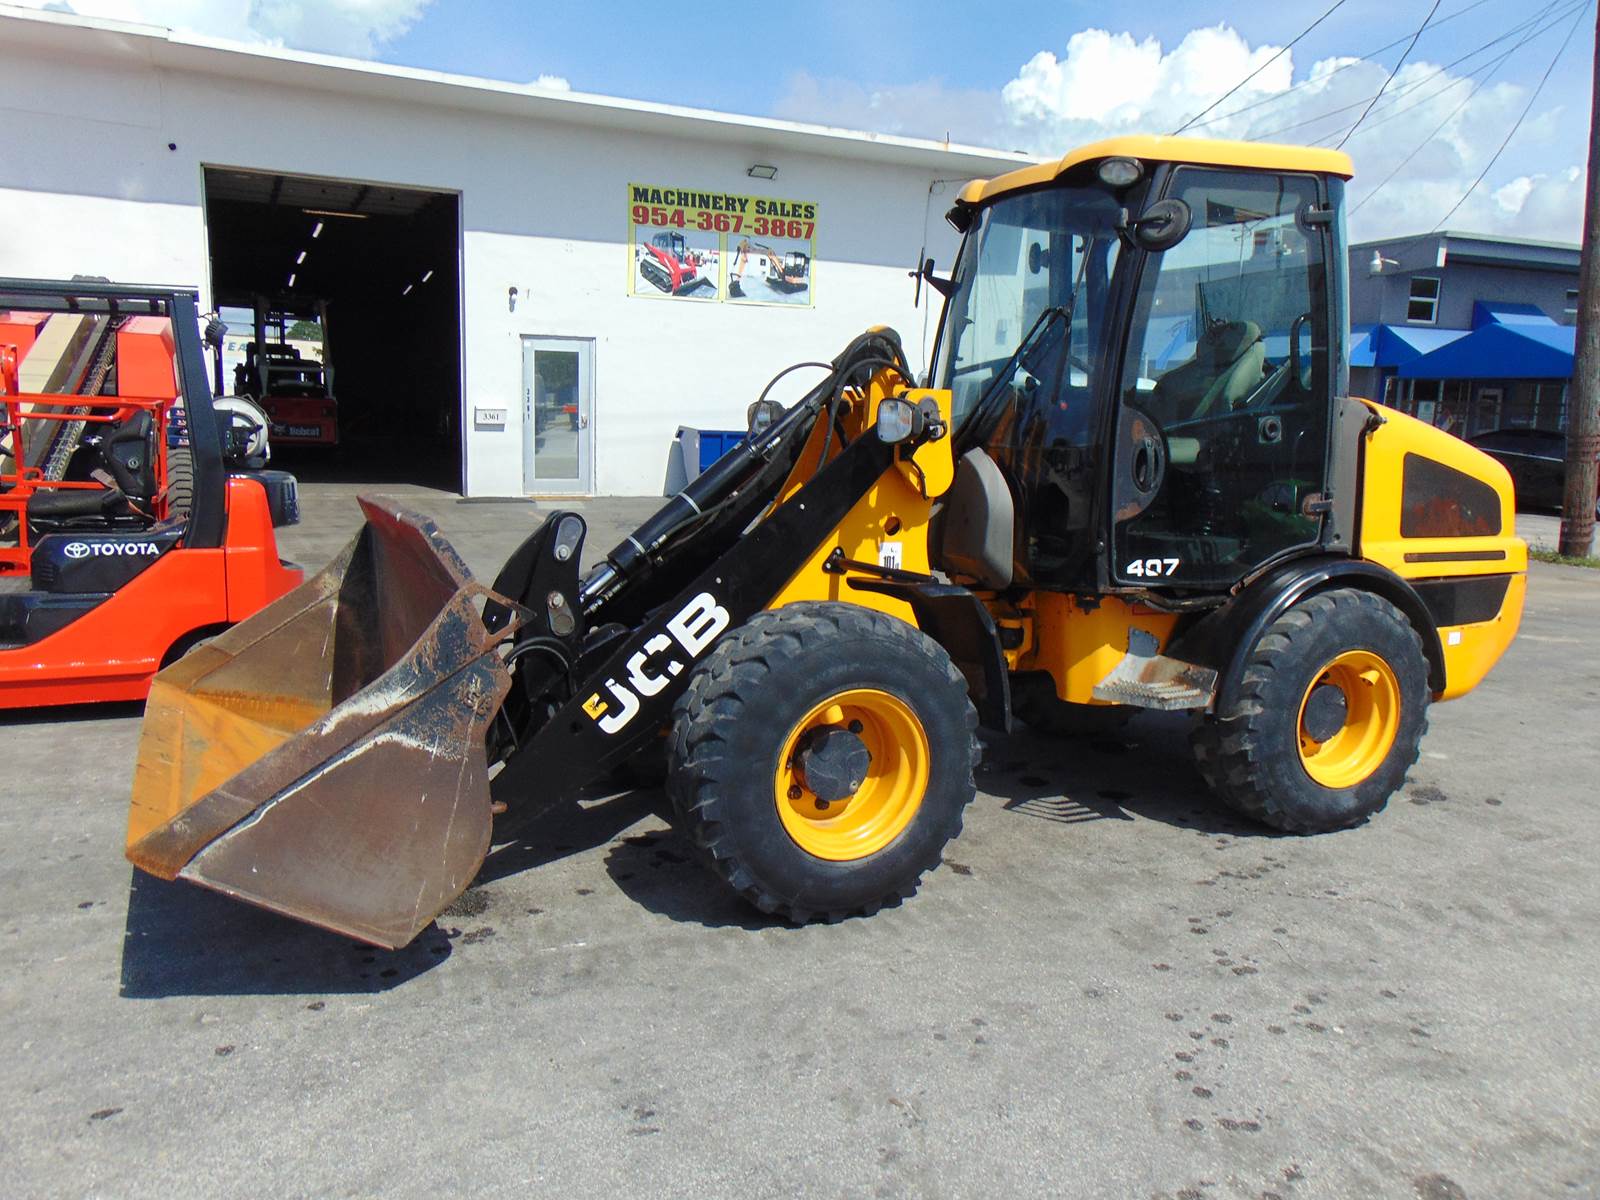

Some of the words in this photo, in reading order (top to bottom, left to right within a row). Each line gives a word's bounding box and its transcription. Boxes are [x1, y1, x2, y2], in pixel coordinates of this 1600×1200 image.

[633, 187, 749, 213] MACHINERY
[755, 199, 815, 219] SALES
[632, 205, 815, 240] 954-367-3867
[482, 412, 499, 421] 3361
[91, 542, 160, 556] TOYOTA
[1126, 558, 1180, 577] 407
[598, 592, 731, 735] JCB
